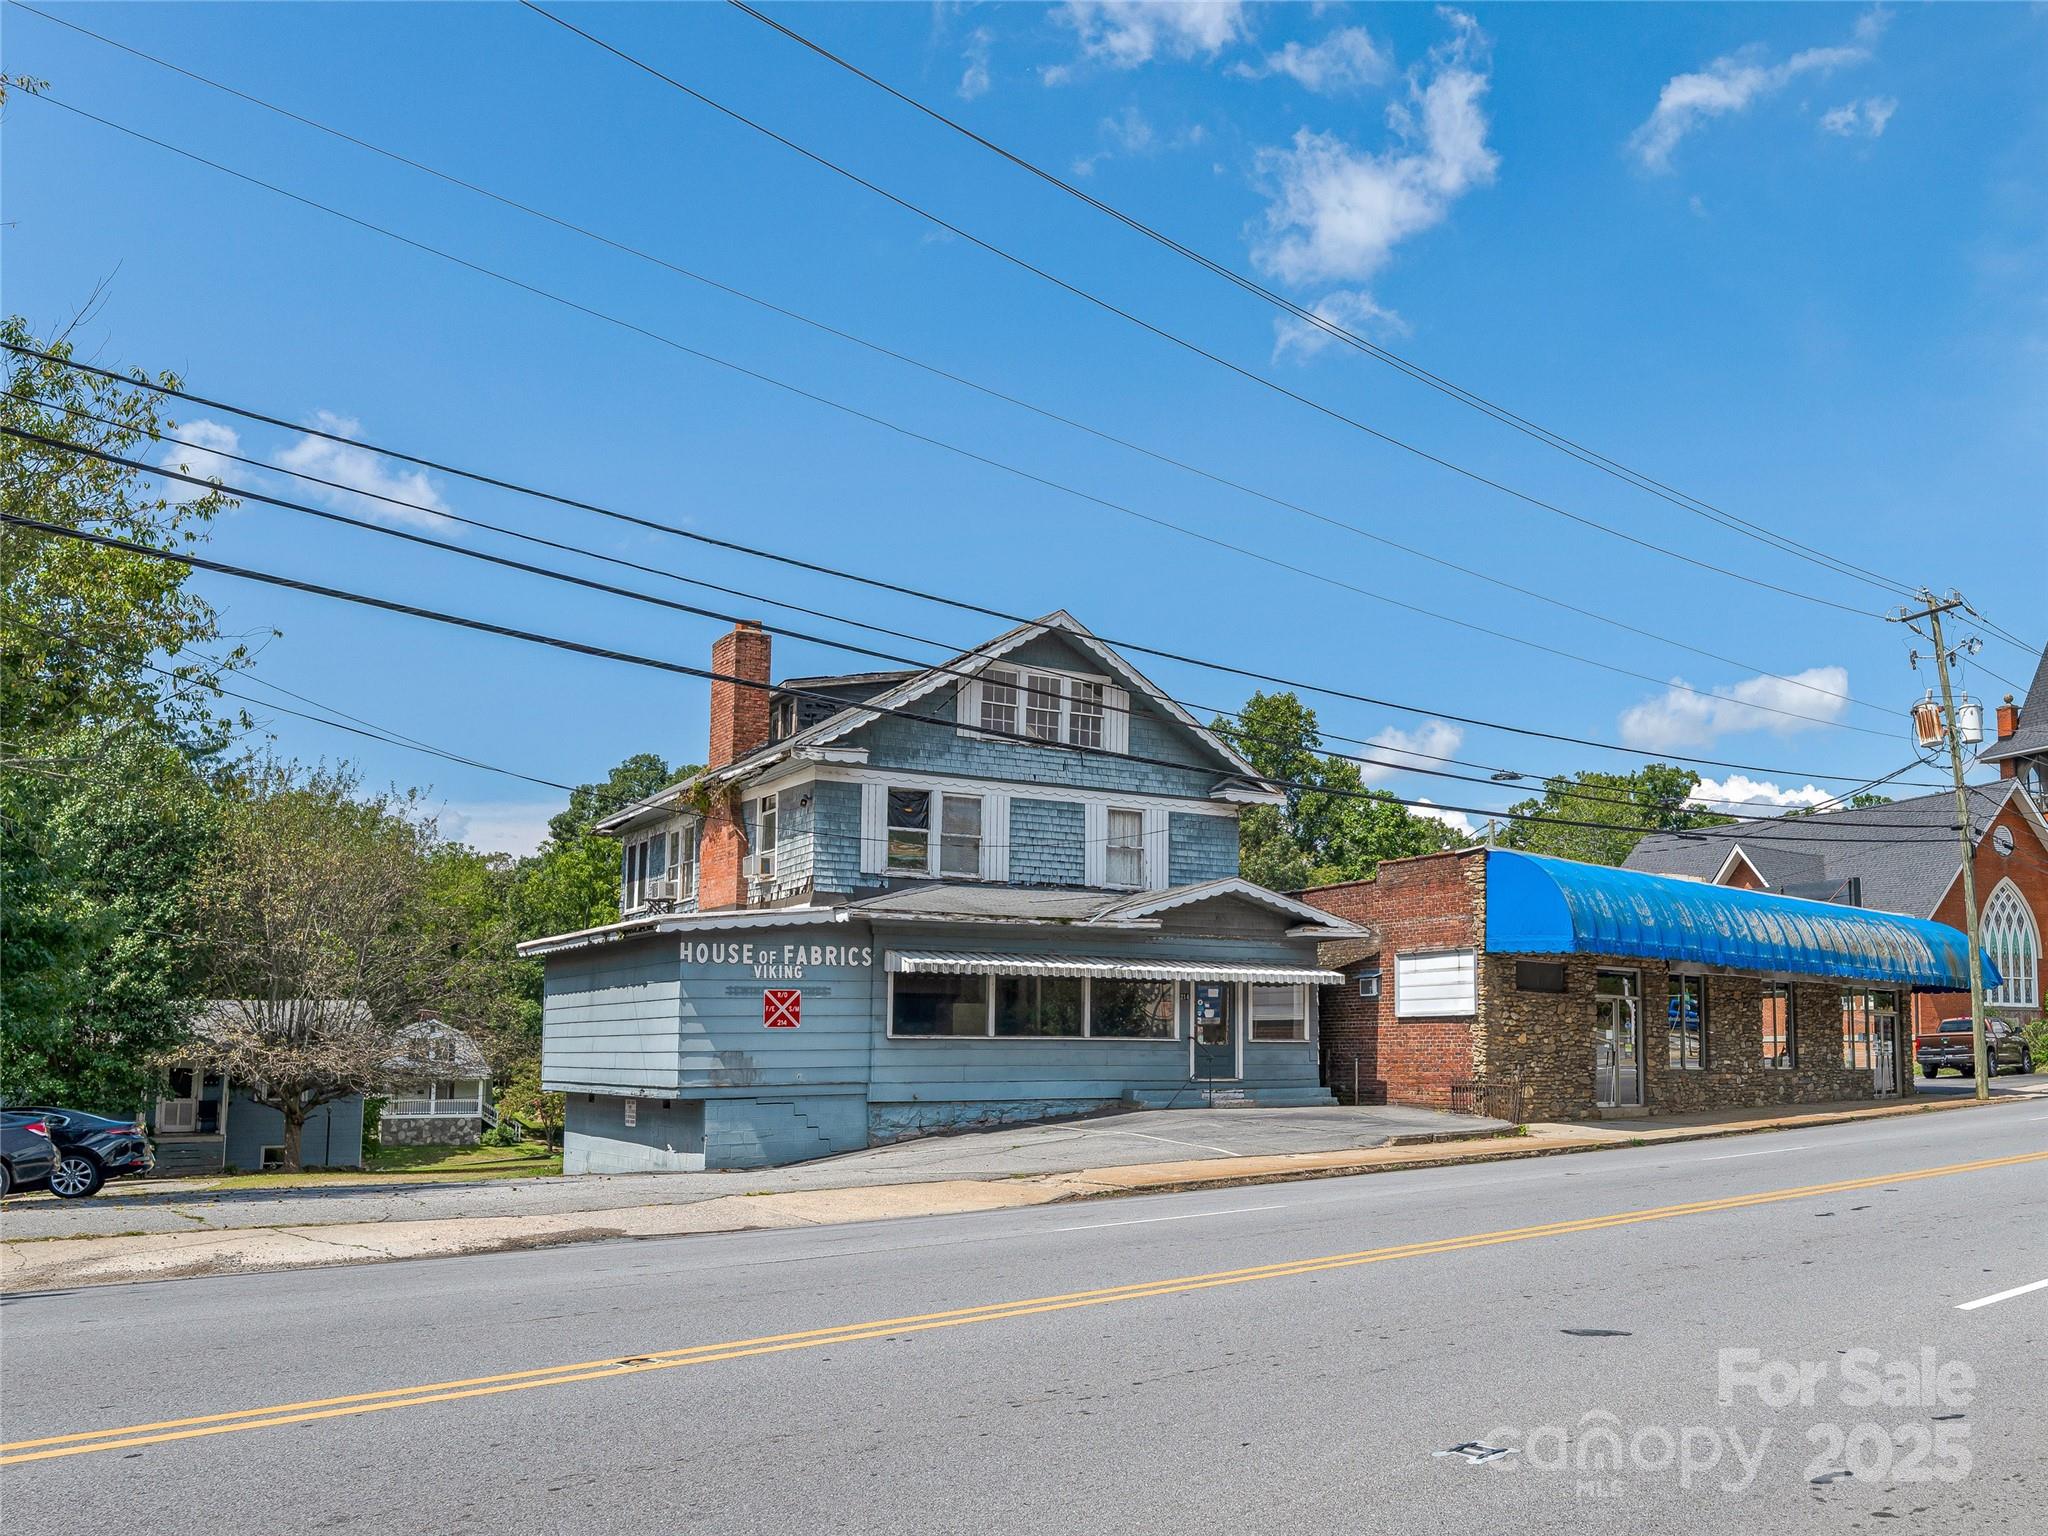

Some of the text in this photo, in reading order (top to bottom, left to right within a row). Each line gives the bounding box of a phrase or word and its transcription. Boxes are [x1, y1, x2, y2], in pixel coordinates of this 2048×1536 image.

[680, 942, 872, 967] HOUSE OF FABRICS
[754, 965, 803, 979] VIKING
